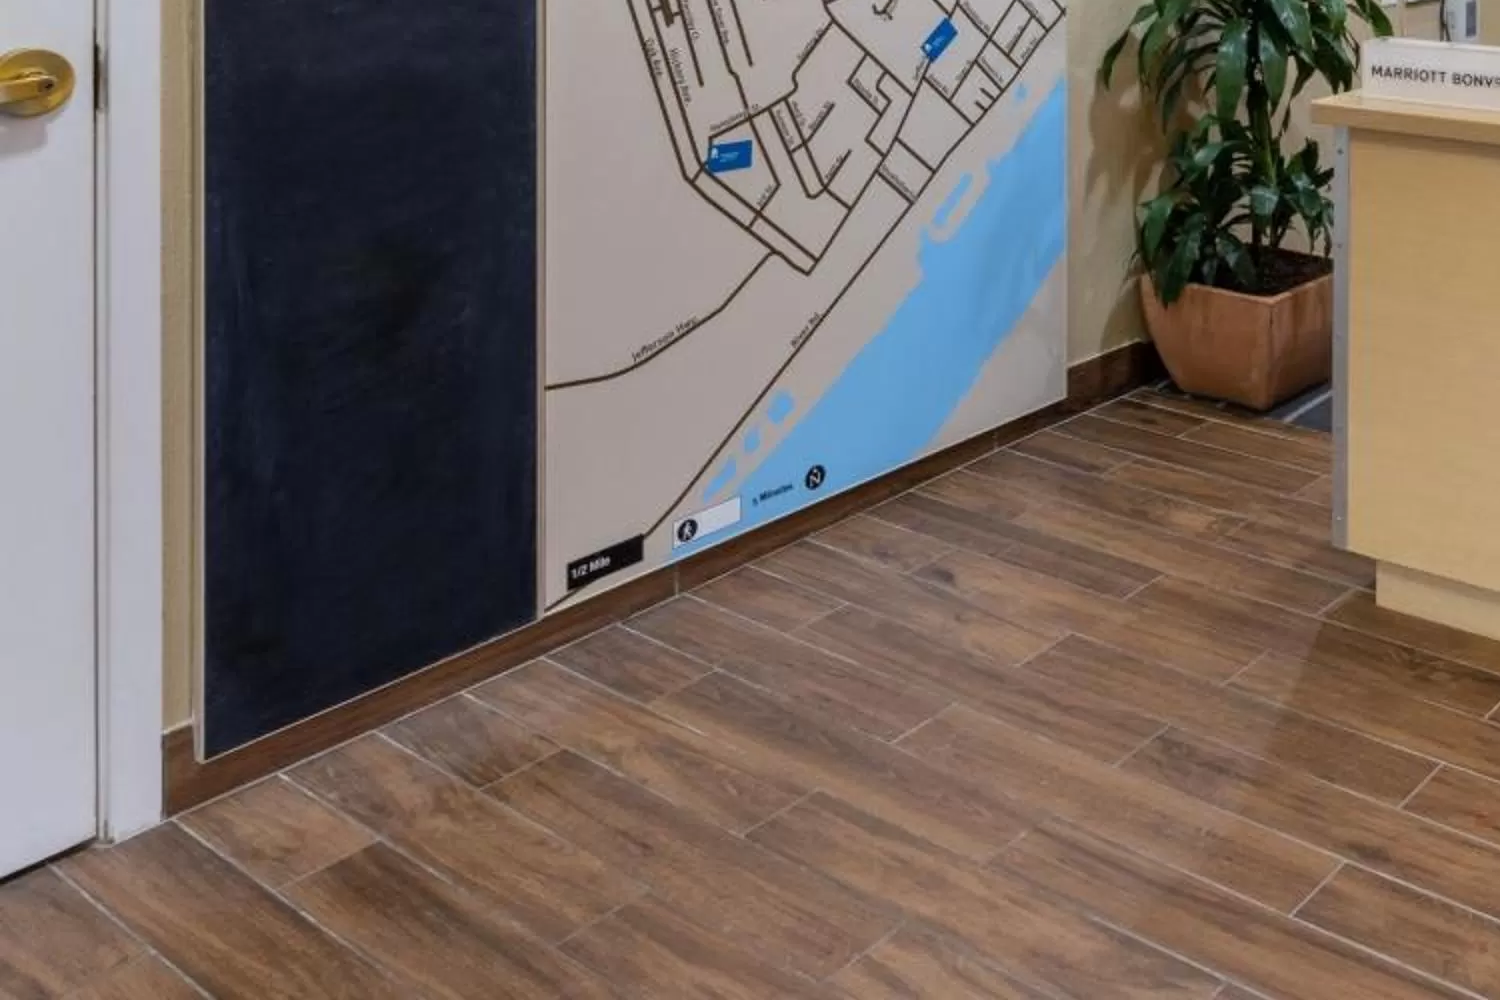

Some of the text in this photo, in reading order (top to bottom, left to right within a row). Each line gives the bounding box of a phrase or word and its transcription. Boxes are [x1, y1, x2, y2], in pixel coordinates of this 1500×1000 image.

[1371, 65, 1447, 84] MARRIOTT
[571, 556, 612, 581] 1/2 Mile
